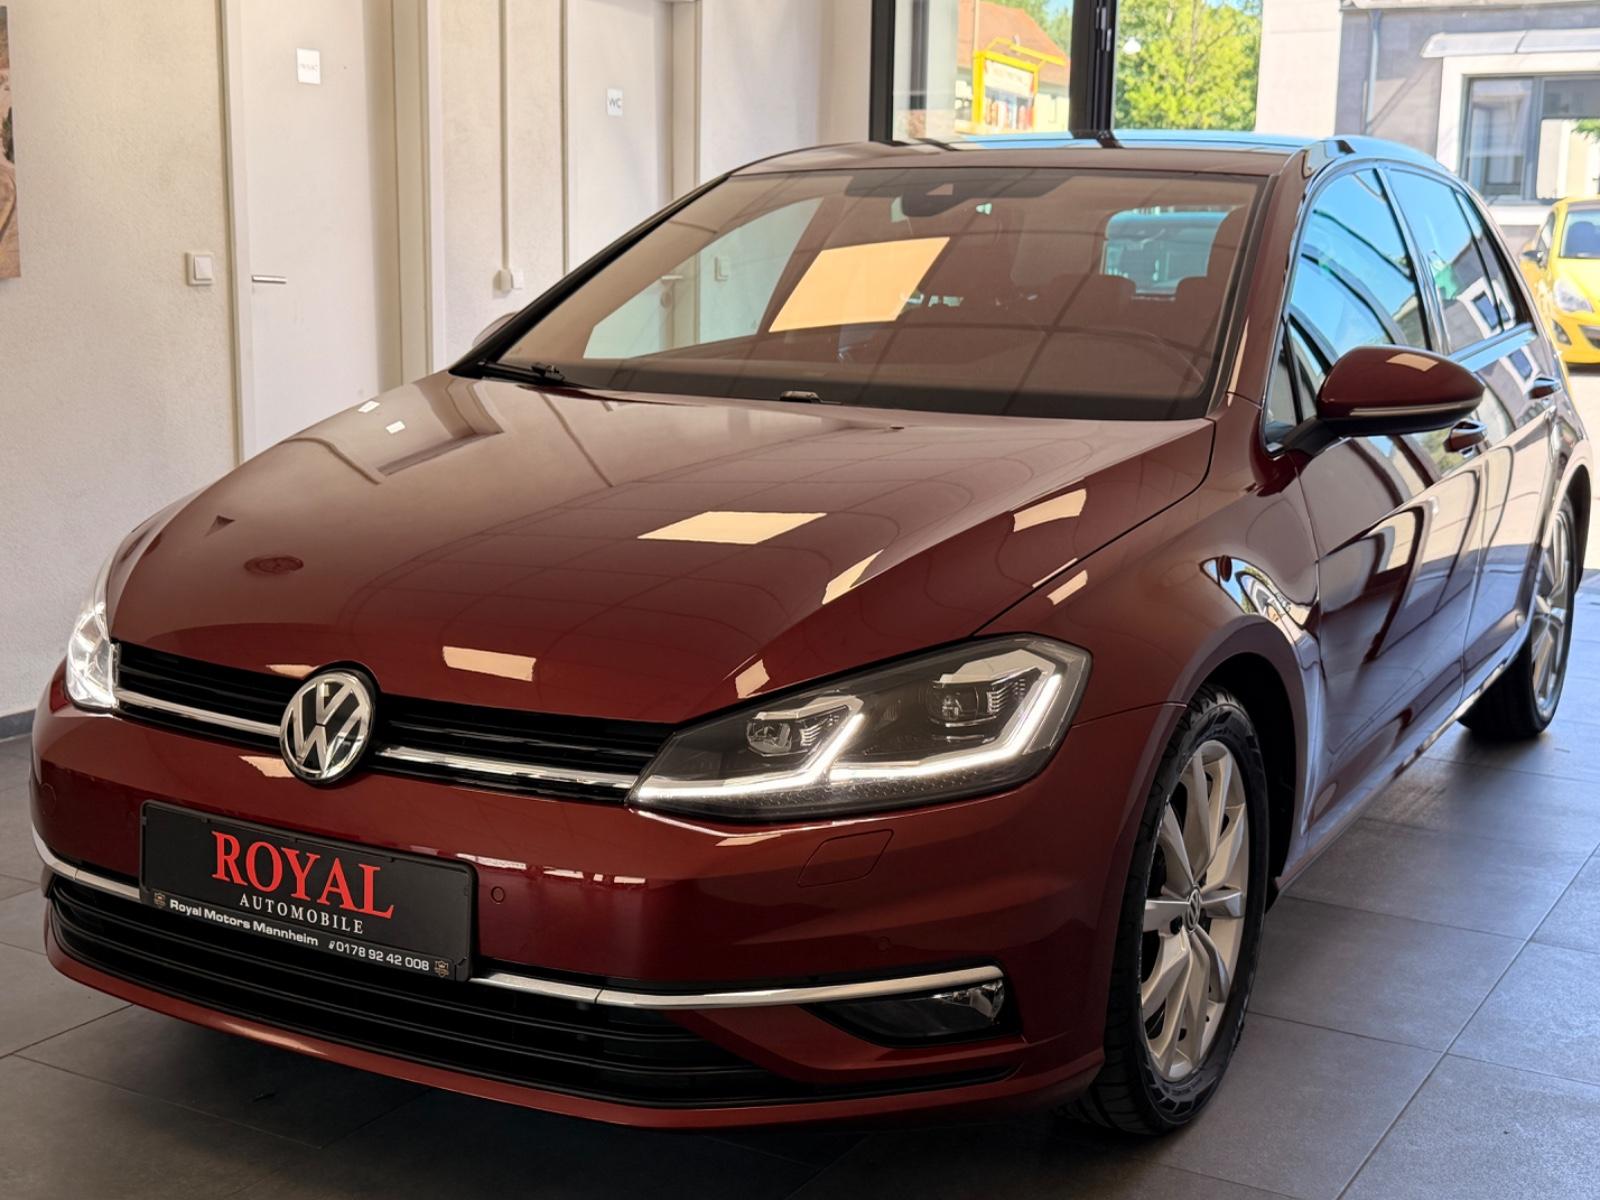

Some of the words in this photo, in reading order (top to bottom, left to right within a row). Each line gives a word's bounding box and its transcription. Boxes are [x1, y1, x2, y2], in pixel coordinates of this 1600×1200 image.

[608, 97, 622, 109] WC
[211, 831, 394, 919] ROYAL
[169, 898, 202, 917] Royal
[204, 908, 251, 930] Motors
[253, 920, 319, 947] Mannheim
[336, 941, 366, 958] 0178
[368, 949, 384, 962] 92
[386, 953, 402, 966] 42
[404, 956, 430, 972] 008
[239, 893, 364, 935] AUTOMOBILE
